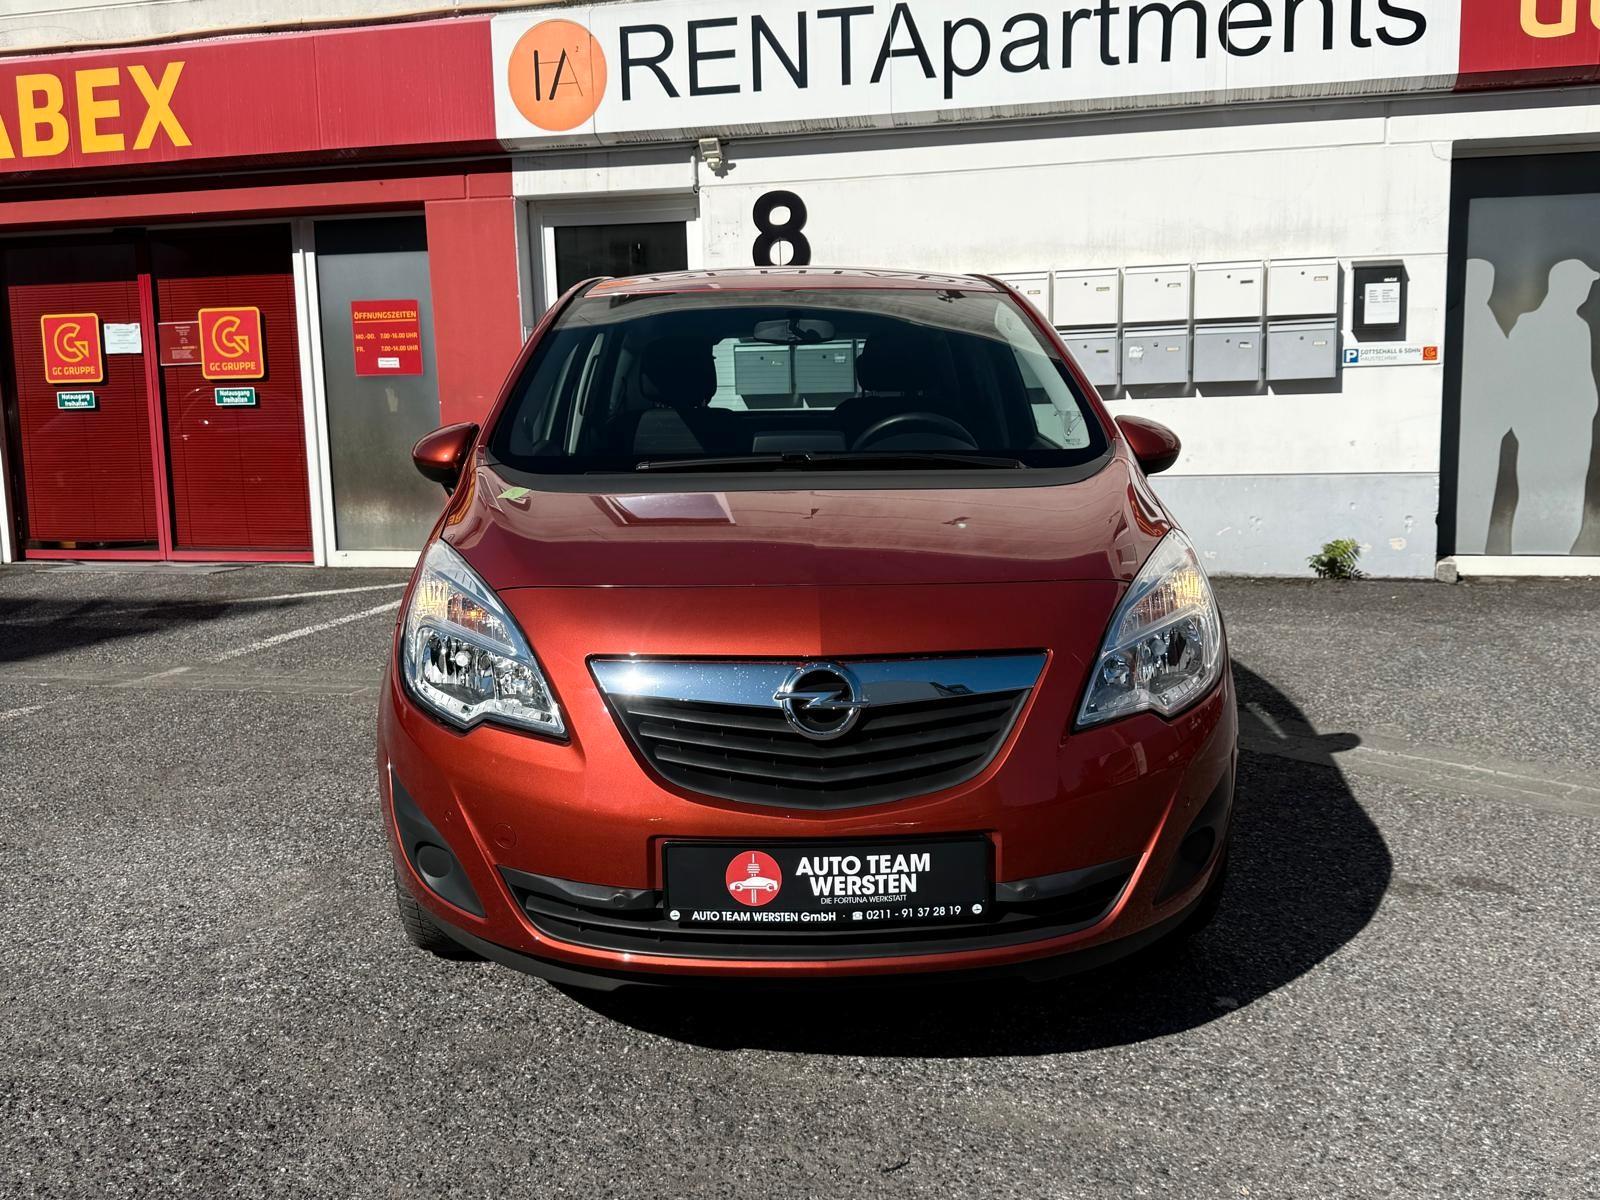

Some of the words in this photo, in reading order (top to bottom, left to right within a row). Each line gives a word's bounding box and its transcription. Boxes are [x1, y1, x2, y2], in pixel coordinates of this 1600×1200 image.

[0, 61, 192, 159] BEX
[752, 190, 811, 266] 8
[353, 310, 416, 320] ÖFFNUNGSZEITEN
[1345, 349, 1358, 363] P
[52, 367, 62, 375] GC
[64, 366, 95, 375] GRUPPE
[209, 362, 220, 371] GC
[222, 361, 256, 371] GRUPPE
[795, 855, 861, 876] AUTO
[866, 853, 931, 874] TEAM
[809, 873, 917, 896] WERSTEN
[834, 896, 868, 904] FORTUNA
[868, 894, 907, 903] WERKSTATT
[692, 911, 720, 921] AUTO
[722, 911, 750, 922] TEAM
[750, 911, 798, 922] WERSTEN
[801, 912, 836, 922] GmbH
[866, 909, 891, 920] 0211
[902, 908, 913, 918] 91
[918, 907, 930, 917] 37
[933, 906, 945, 916] 28
[950, 905, 961, 915] 19
